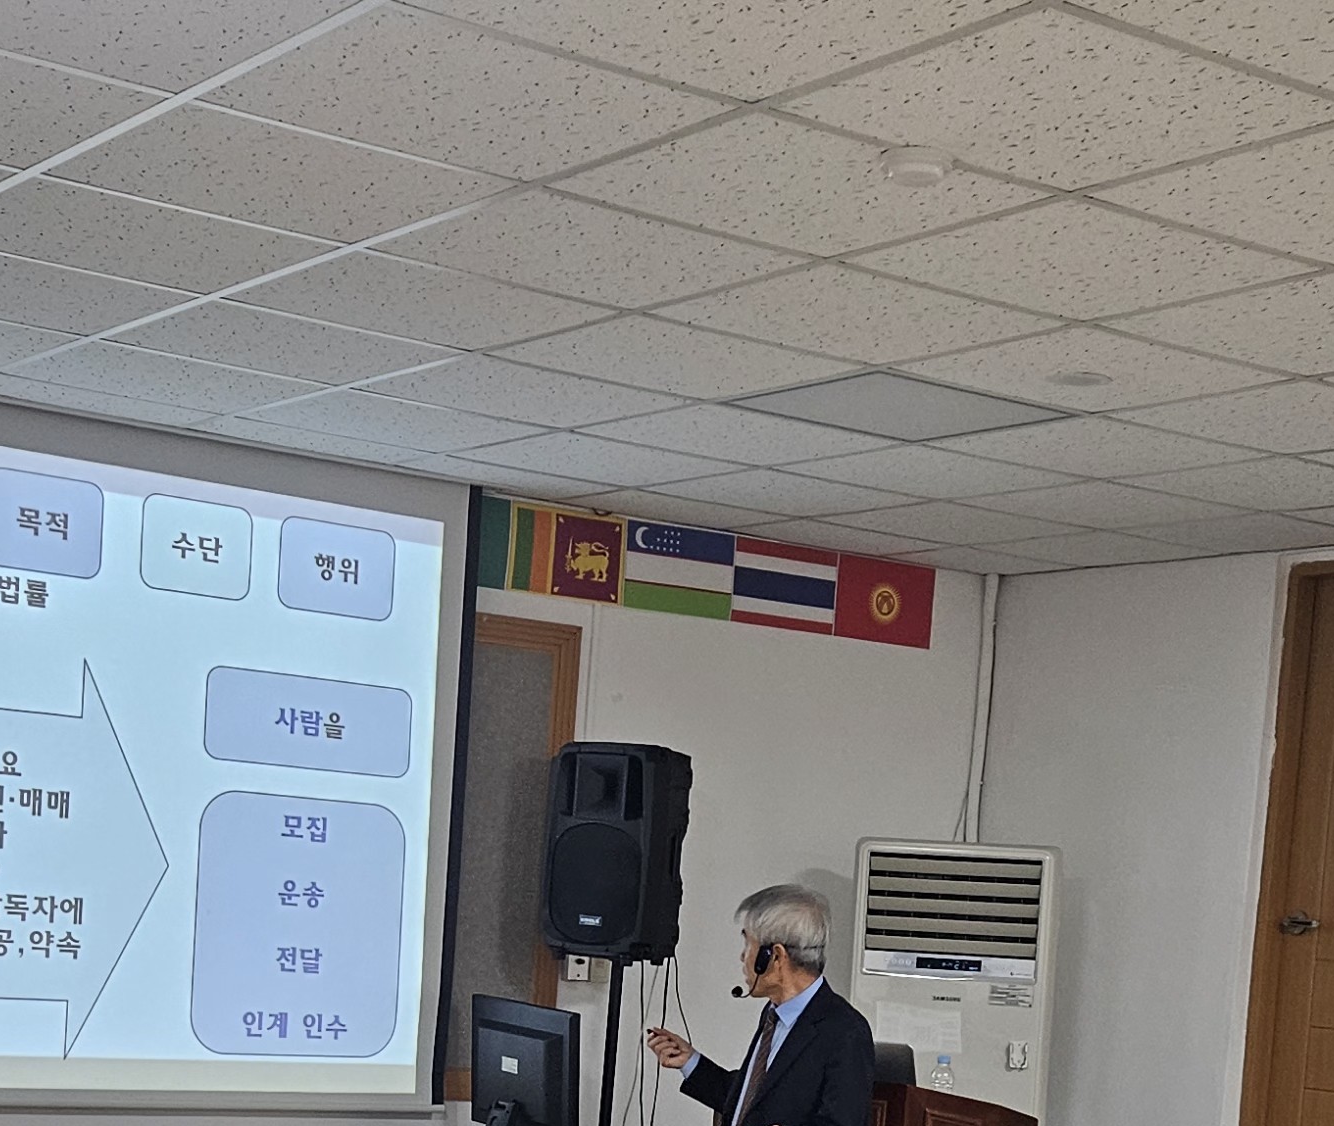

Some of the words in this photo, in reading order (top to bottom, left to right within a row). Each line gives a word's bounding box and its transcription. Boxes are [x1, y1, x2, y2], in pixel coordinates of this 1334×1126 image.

[16, 506, 70, 541] 목적
[171, 532, 223, 564] 수단
[314, 552, 359, 585] 행위
[273, 707, 346, 740] 사람을
[280, 814, 328, 843] 모집
[277, 879, 325, 909] 운송
[275, 946, 323, 975] 전달
[242, 1011, 289, 1039] 인계
[302, 1013, 348, 1040] 인수
